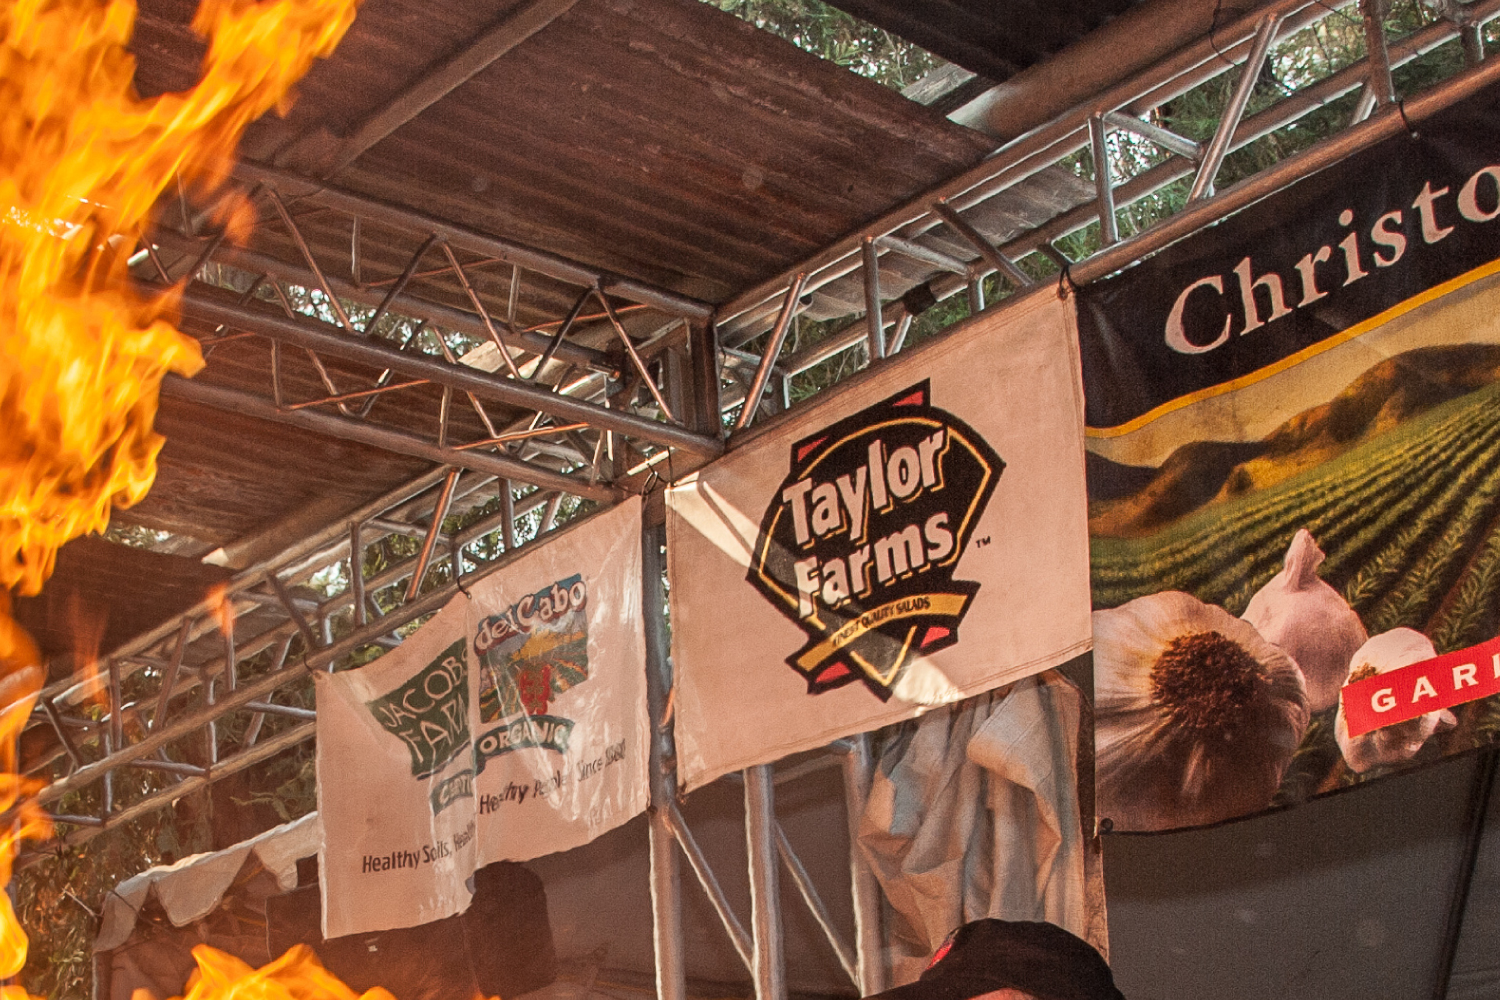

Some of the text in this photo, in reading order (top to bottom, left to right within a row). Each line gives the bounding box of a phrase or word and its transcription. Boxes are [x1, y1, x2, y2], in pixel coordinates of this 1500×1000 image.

[1164, 165, 1500, 354] Christo
[782, 430, 945, 545] Taylor
[794, 512, 954, 618] Farms
[896, 596, 931, 614] SALADS
[362, 850, 420, 873] Healthy
